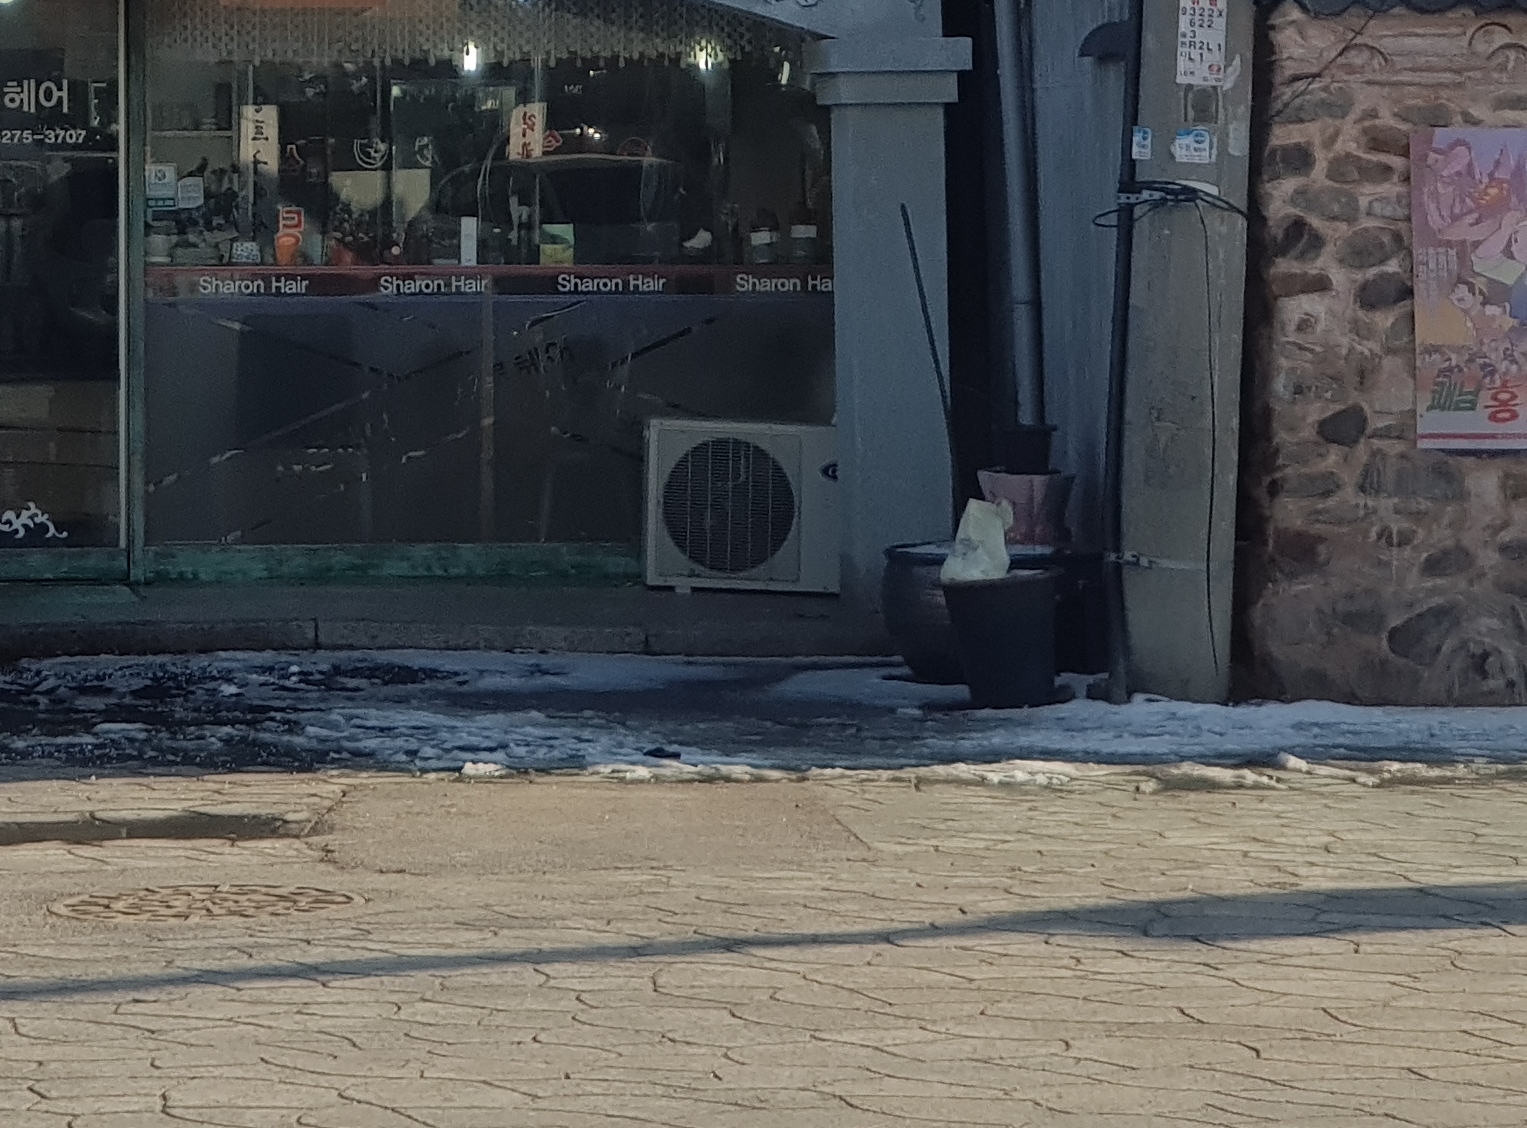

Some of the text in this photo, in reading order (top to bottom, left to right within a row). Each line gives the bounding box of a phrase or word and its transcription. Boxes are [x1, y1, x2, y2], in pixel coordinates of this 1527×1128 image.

[1189, 17, 1214, 28] 622
[199, 275, 309, 295] Sharon Hair
[380, 275, 487, 294] Sharon Hair
[557, 273, 667, 292] Sharon Hair
[735, 273, 833, 292] Sharon Ha
